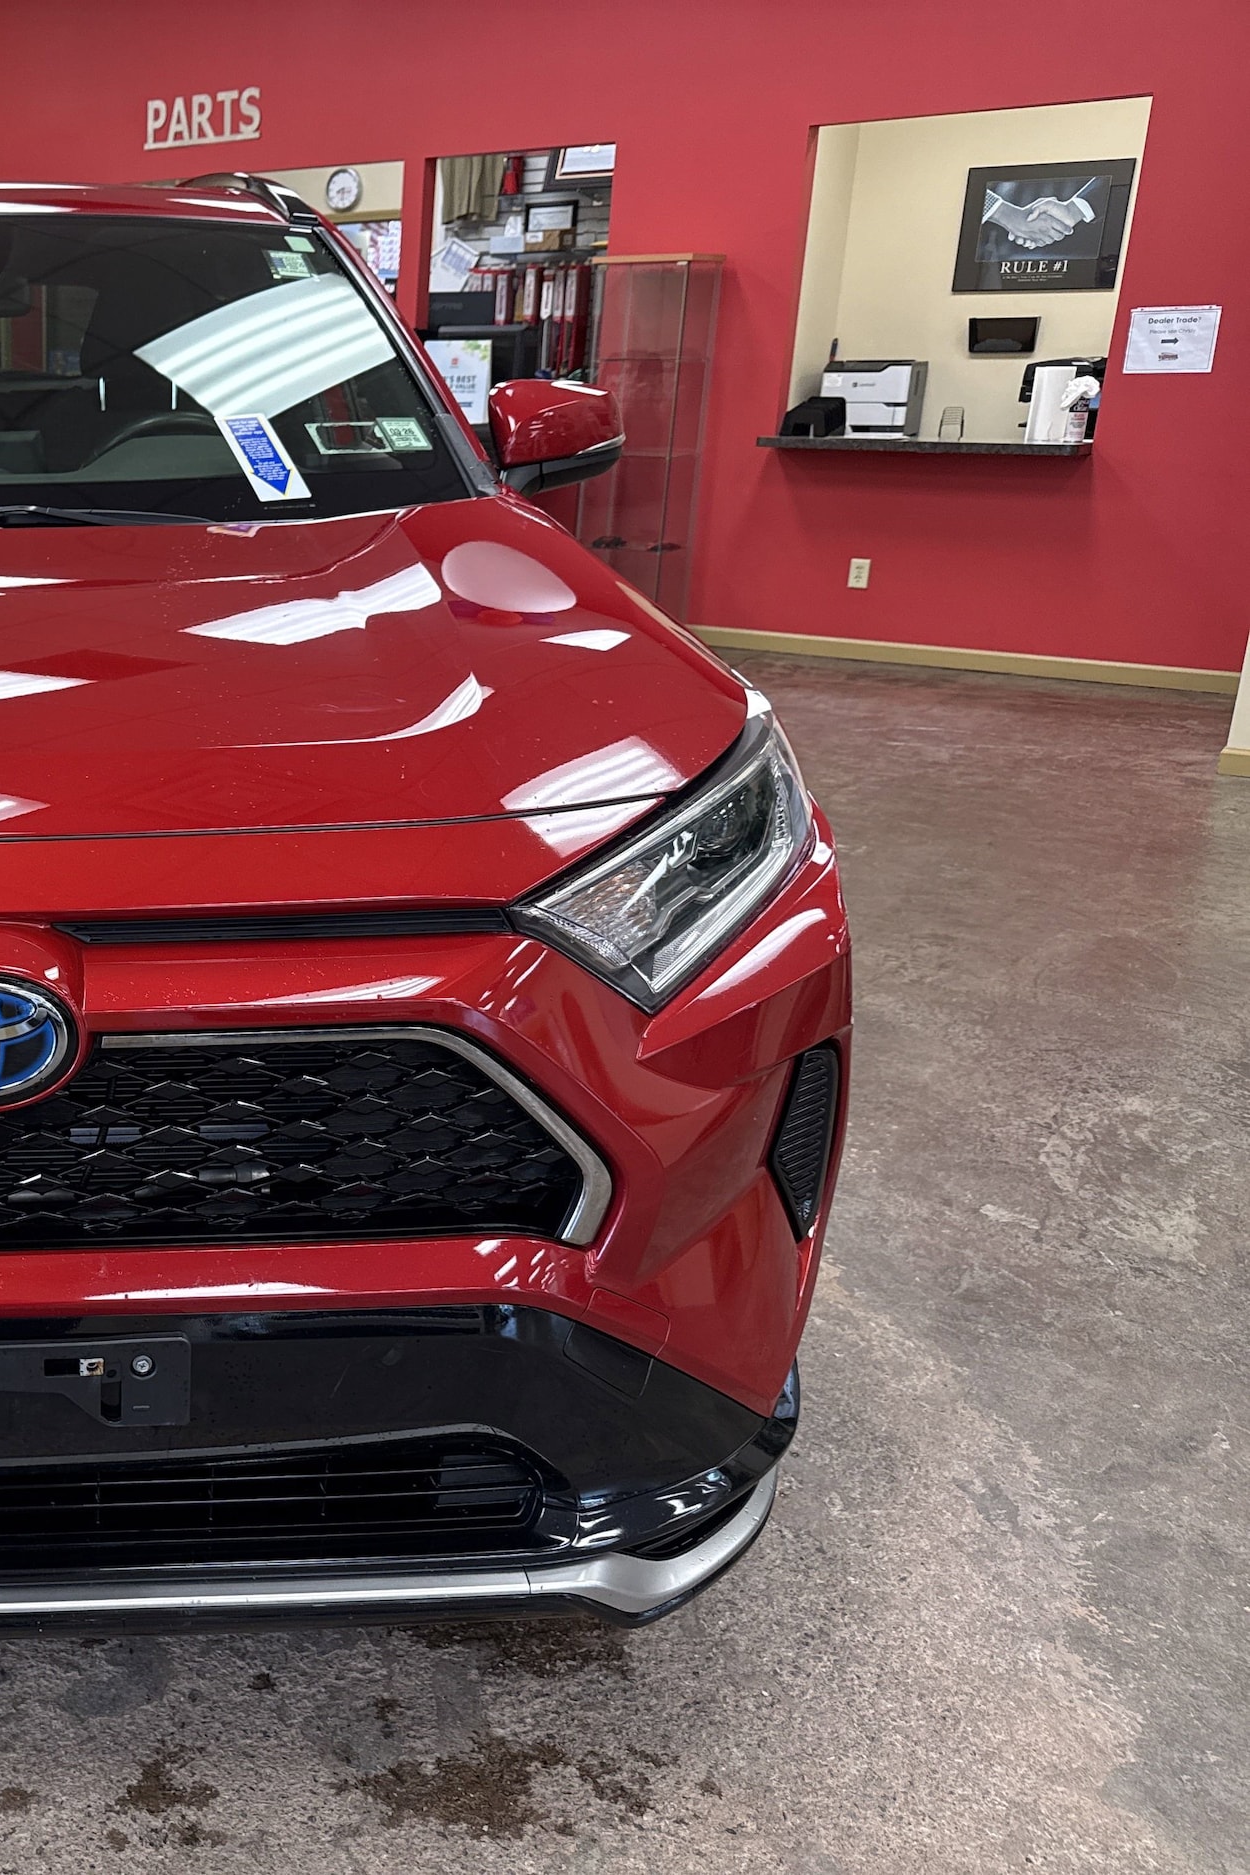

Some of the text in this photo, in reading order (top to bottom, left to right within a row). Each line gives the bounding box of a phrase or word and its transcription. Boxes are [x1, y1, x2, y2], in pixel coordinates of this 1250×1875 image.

[144, 86, 261, 150] PARTS
[1000, 260, 1068, 274] RULE #1
[1148, 316, 1202, 325] Dealer Trade?
